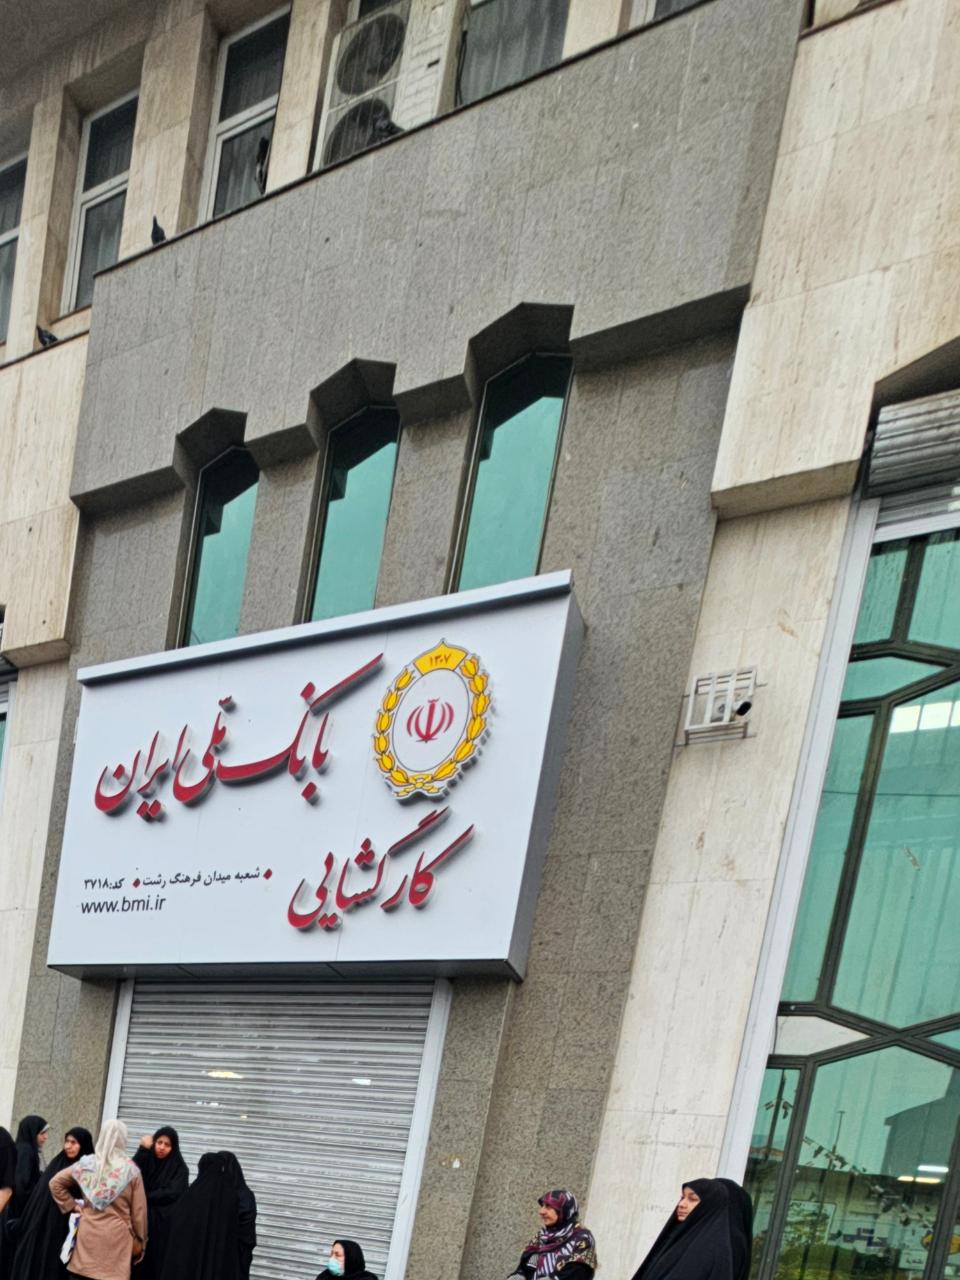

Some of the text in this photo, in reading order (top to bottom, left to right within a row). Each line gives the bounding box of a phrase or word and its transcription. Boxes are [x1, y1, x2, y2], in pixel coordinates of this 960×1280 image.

[215, 652, 384, 800] بانک
[94, 723, 189, 820] ایران
[142, 873, 167, 889] رشت
[169, 871, 202, 887] فرهنگ
[203, 870, 232, 887] میدان
[234, 866, 260, 883] شعبه
[81, 894, 167, 914] www.bmi.ir
